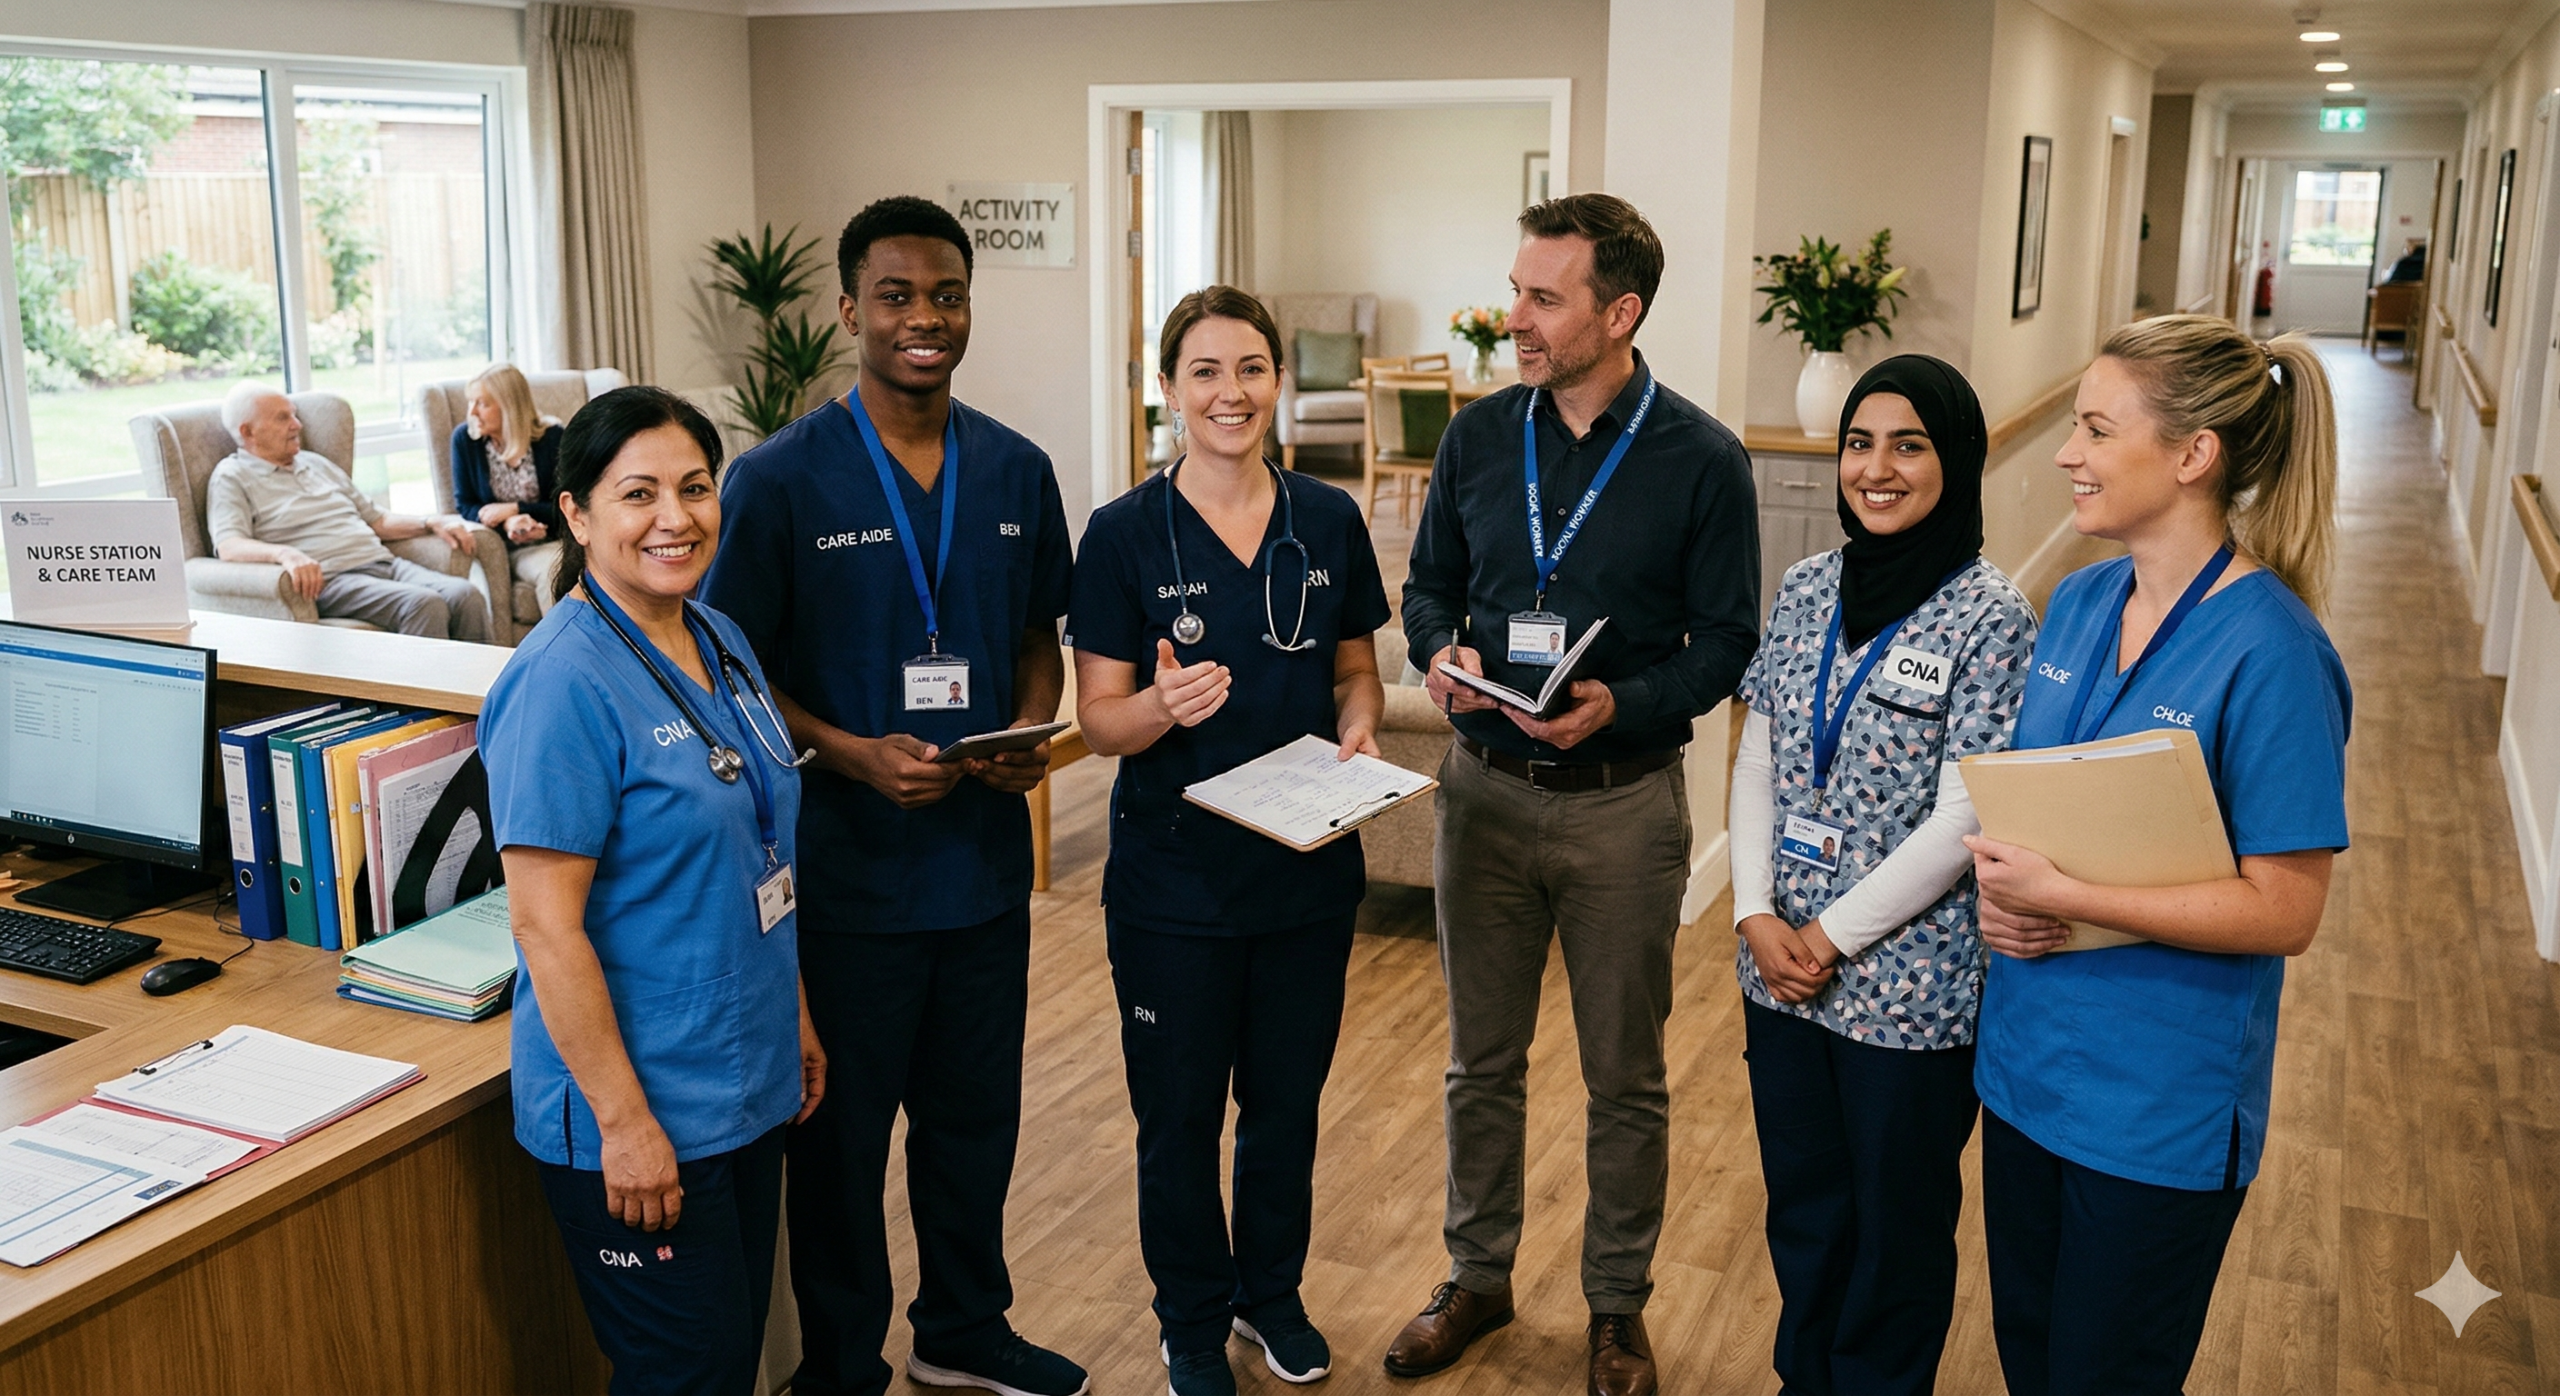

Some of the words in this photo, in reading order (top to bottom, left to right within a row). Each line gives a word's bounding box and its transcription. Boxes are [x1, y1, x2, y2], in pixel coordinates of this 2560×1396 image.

[959, 198, 1060, 221] ACTIVITY
[975, 229, 1045, 250] ROOM
[816, 532, 858, 550] CARE
[860, 528, 894, 544] AIDE
[26, 545, 86, 560] NURSE
[89, 545, 162, 560] STATION
[38, 567, 52, 582] &
[56, 567, 101, 582] CARE
[105, 567, 157, 582] TEAM
[1307, 569, 1330, 586] RN
[1897, 657, 1940, 685] CNA
[2152, 705, 2195, 727] CHLOE
[653, 718, 697, 747] CNA
[1134, 1005, 1155, 1024] RN
[599, 1248, 643, 1268] CNA
